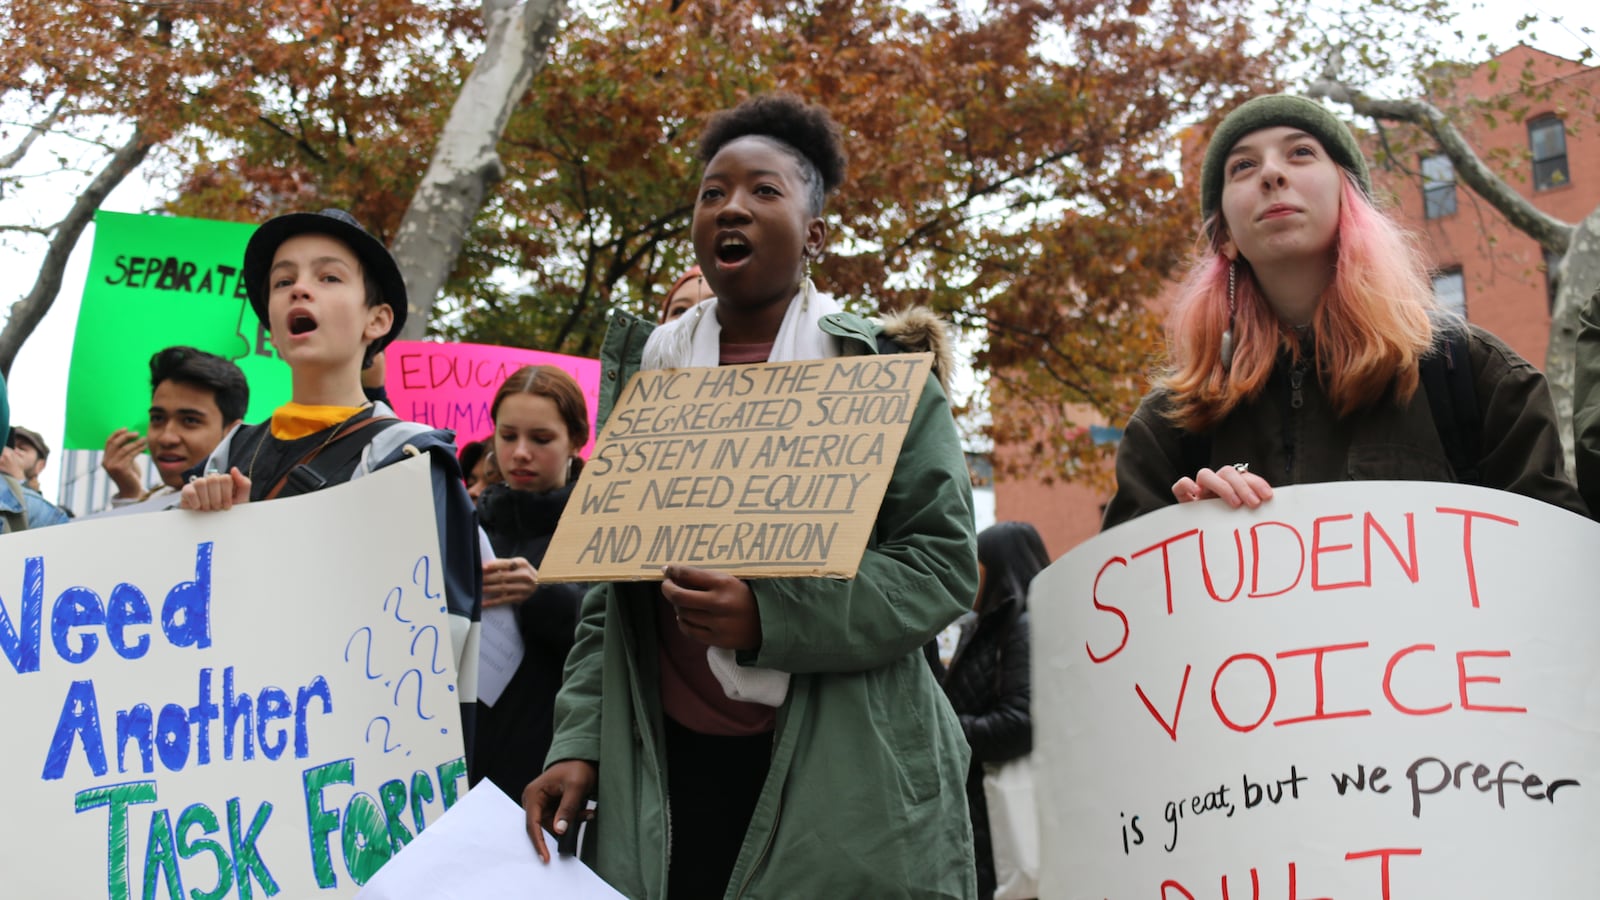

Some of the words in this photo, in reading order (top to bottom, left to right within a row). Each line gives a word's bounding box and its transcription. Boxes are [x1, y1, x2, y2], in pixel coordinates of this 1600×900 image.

[626, 373, 689, 405] NYC
[694, 367, 755, 398] HAS
[763, 363, 824, 393] THE
[824, 359, 924, 390] MOST
[609, 399, 802, 437] SEGREGATED
[808, 394, 911, 427] SCHOOL
[592, 438, 708, 476] SYSTEM
[711, 437, 749, 470] IN
[751, 432, 884, 469] AMERICA
[580, 480, 631, 515] WE
[638, 475, 734, 511] NEED
[738, 473, 871, 511] EQUITY
[576, 526, 642, 564] AND
[645, 521, 839, 562] INTEGRATION
[1086, 507, 1519, 664] STUDENT
[1135, 641, 1528, 742] VOICE
[41, 666, 333, 780] Another
[1119, 811, 1145, 855] is
[1242, 765, 1309, 809] but
[1331, 764, 1392, 796] we
[1406, 756, 1581, 819] prefer
